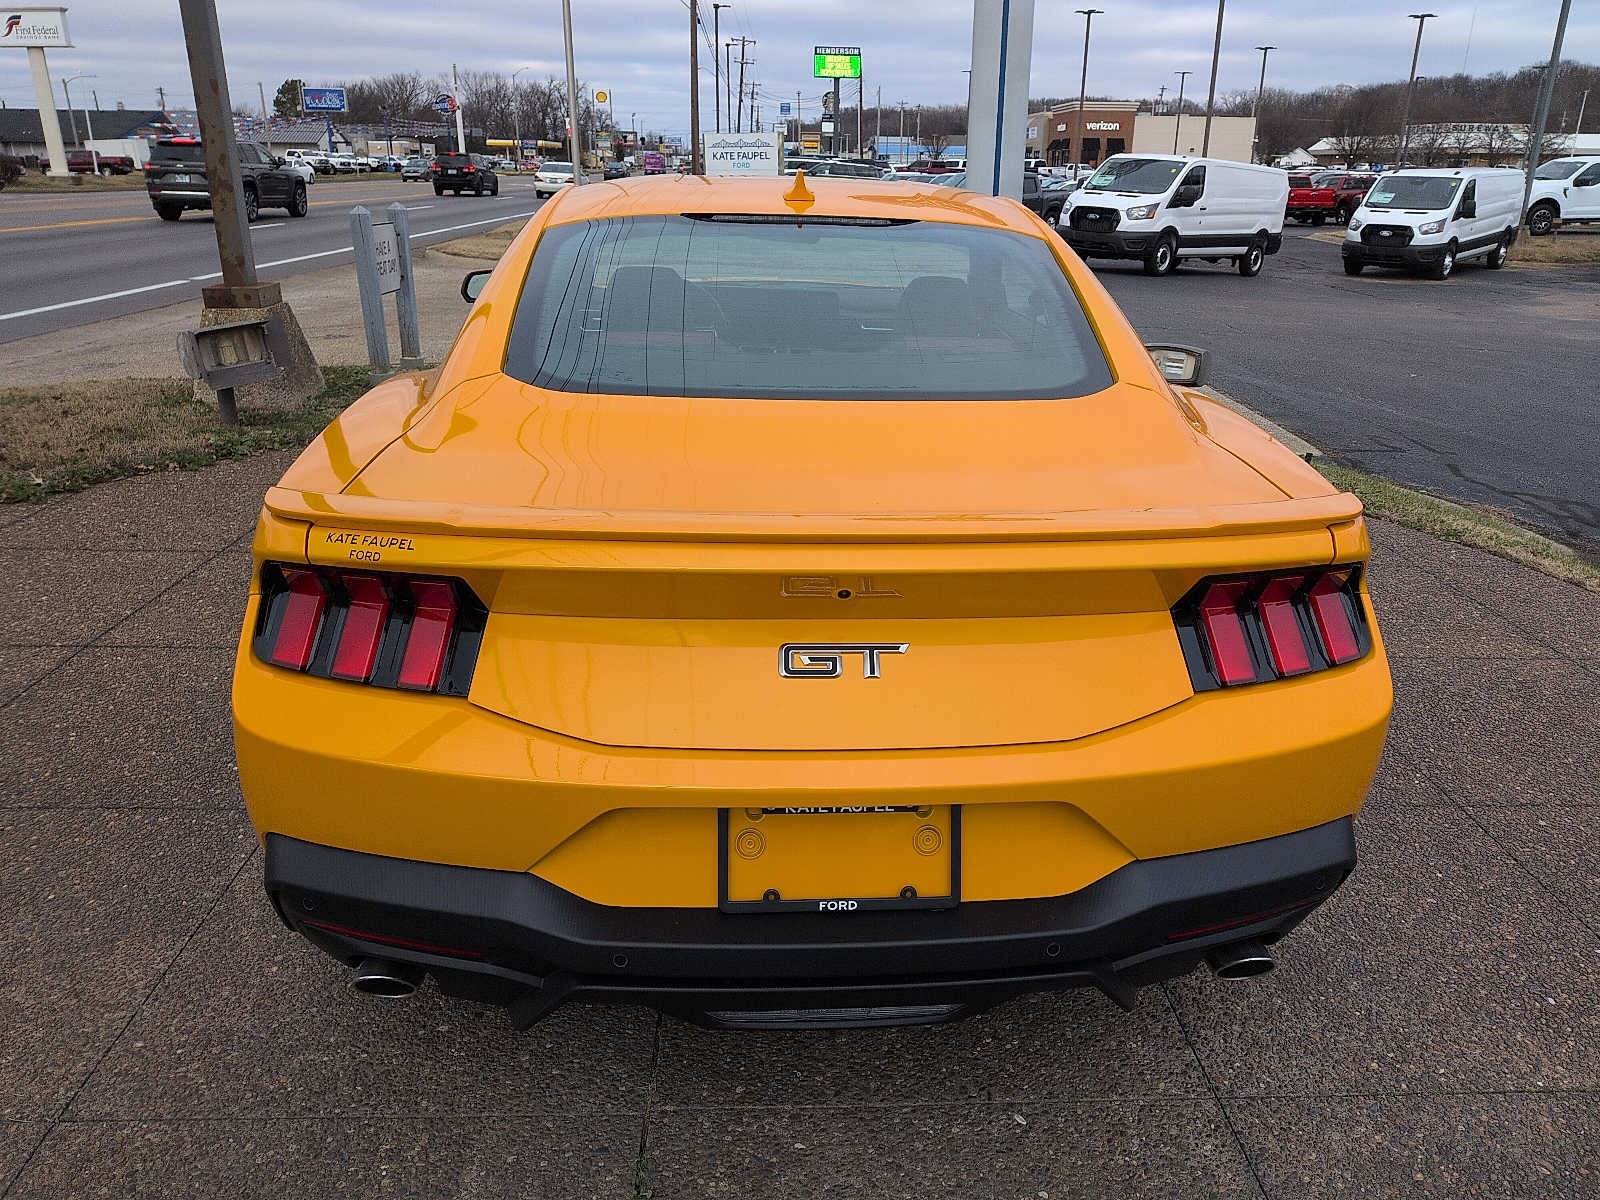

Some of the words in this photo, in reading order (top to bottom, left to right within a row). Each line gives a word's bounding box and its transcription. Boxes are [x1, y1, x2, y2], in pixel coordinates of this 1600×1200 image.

[15, 26, 31, 35] First
[32, 25, 58, 35] Federal
[816, 47, 860, 55] HENDERSON
[1086, 120, 1120, 131] verizon
[712, 151, 735, 161] KATE
[737, 151, 770, 160] FAUPEL
[325, 531, 361, 545] KATE
[361, 535, 415, 551] FAUPEL
[349, 549, 382, 562] FORD
[778, 642, 911, 679] GT
[818, 900, 858, 912] FORD
